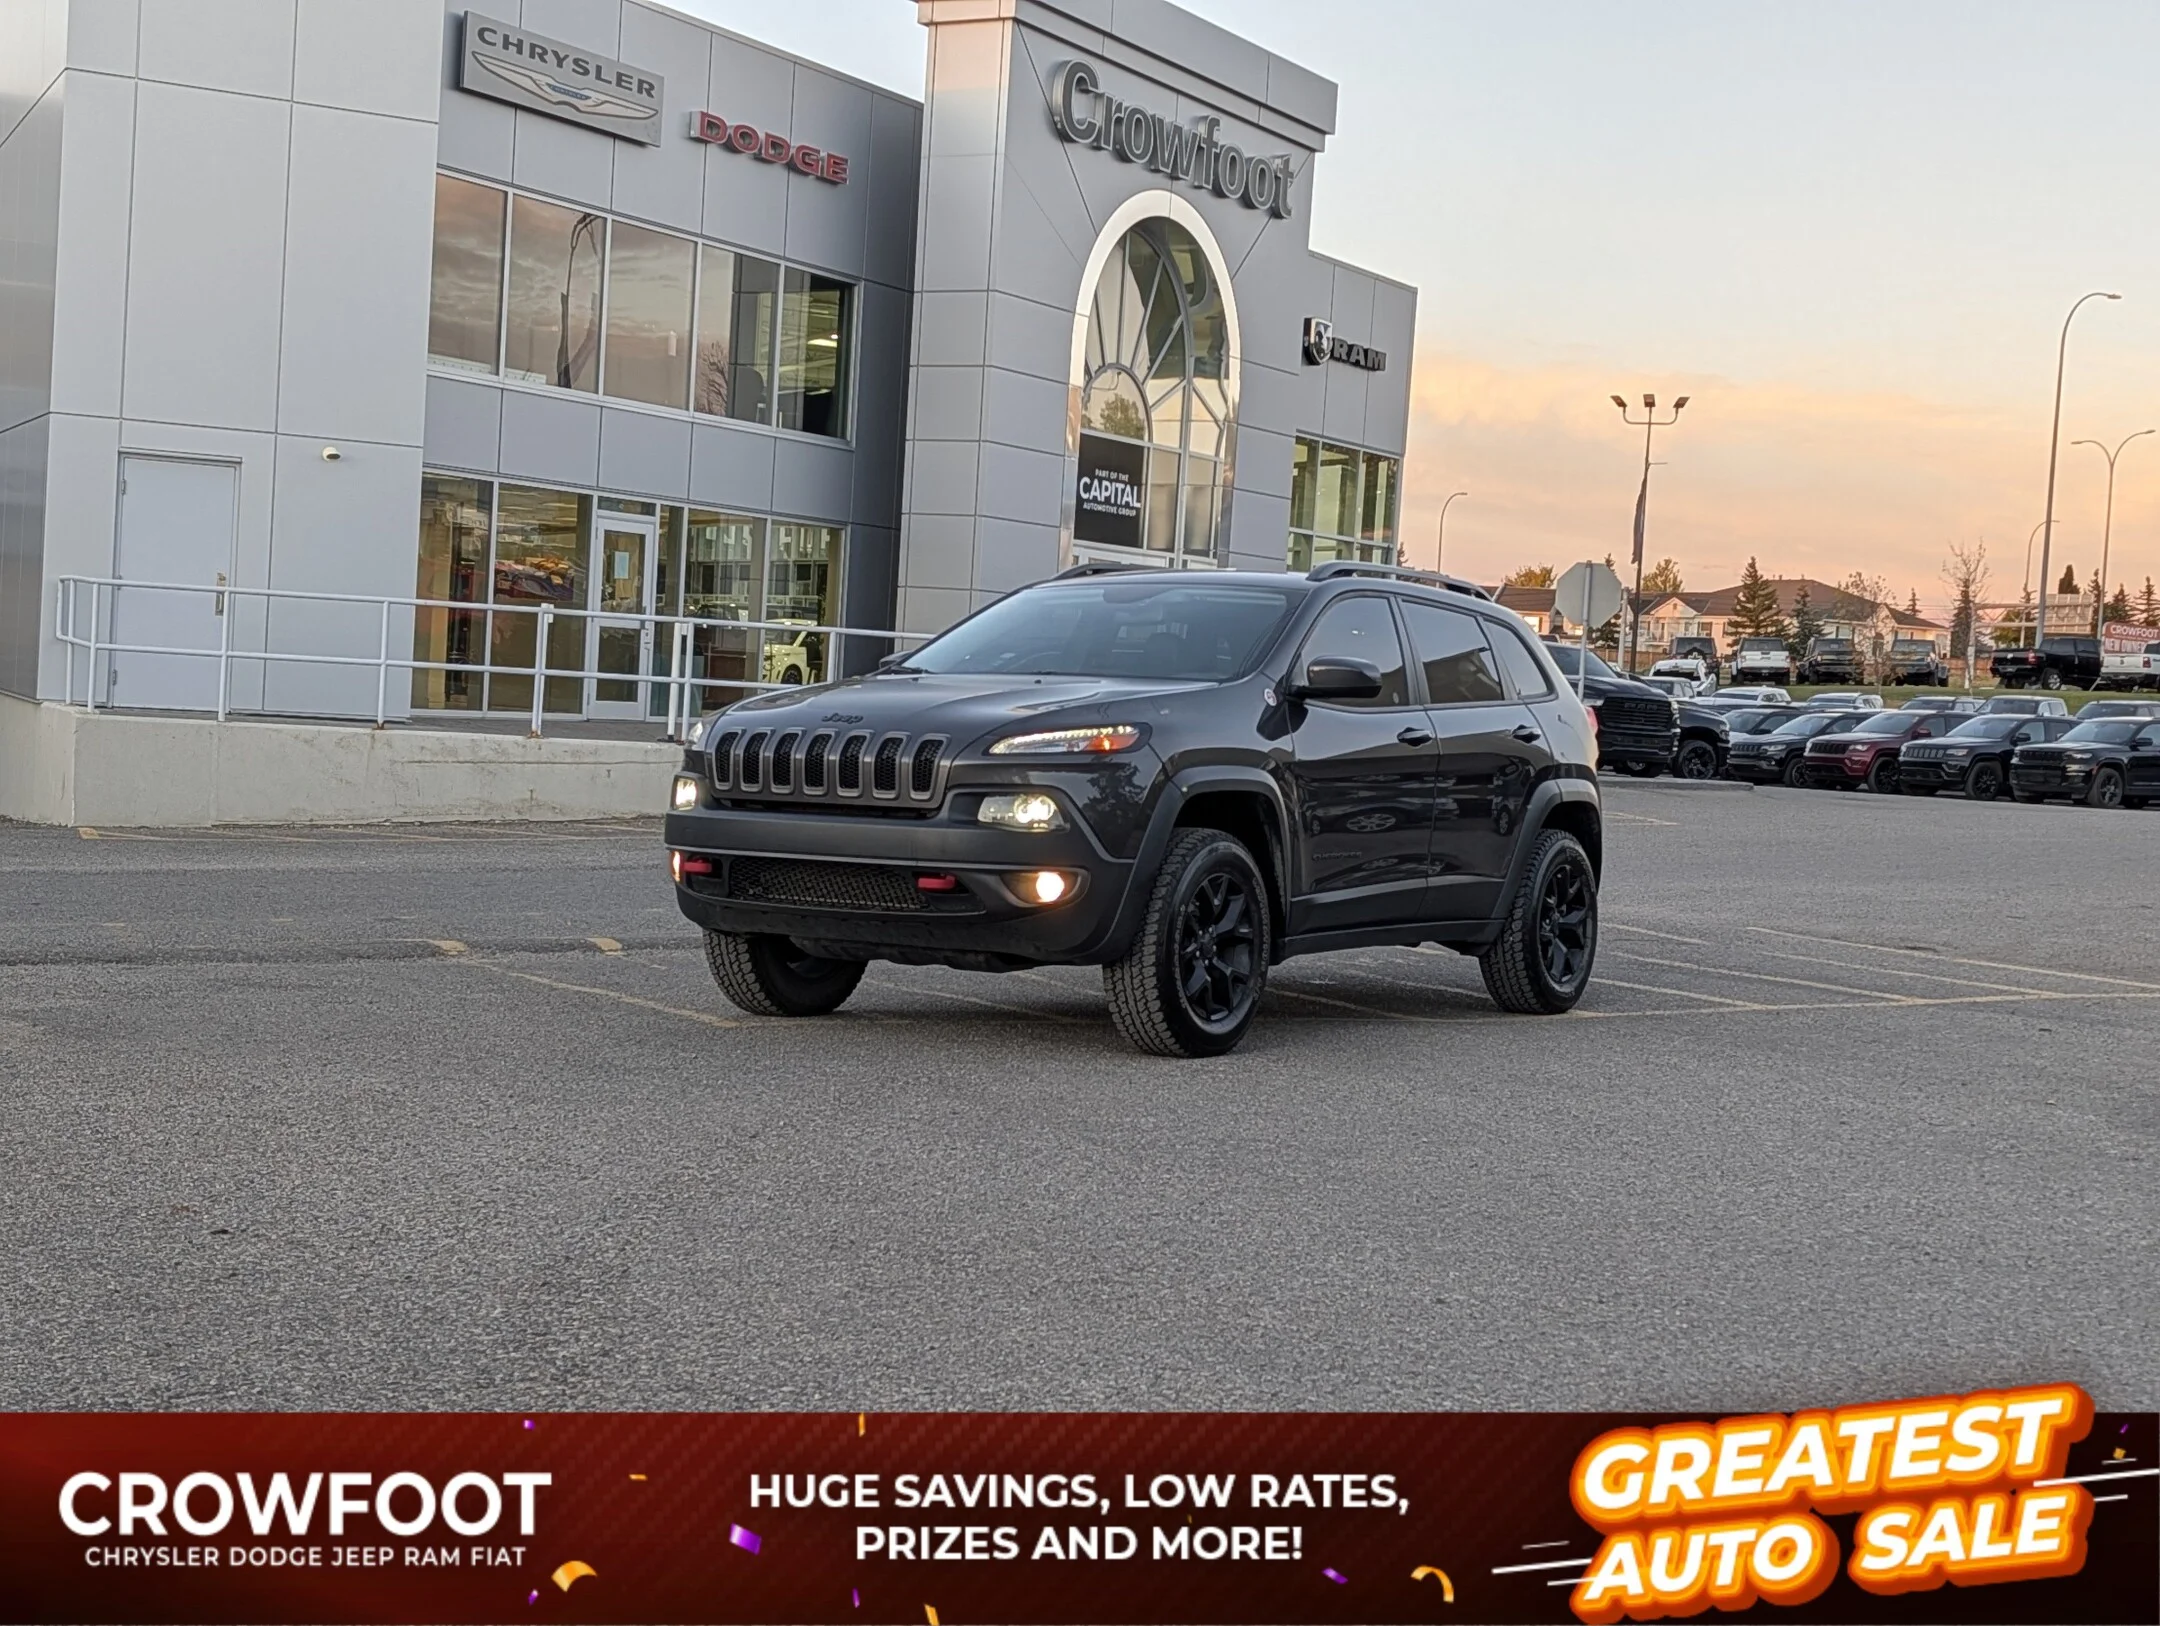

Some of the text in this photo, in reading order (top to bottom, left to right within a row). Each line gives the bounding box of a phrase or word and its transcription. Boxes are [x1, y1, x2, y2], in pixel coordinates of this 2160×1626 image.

[476, 26, 657, 99] CHRYSLER
[691, 110, 850, 185] DODGE
[1053, 59, 1296, 219] Crowfoot
[1330, 337, 1387, 371] RAM
[1095, 468, 1129, 482] PART OF THE
[1079, 476, 1141, 508] CAPITAL
[1083, 502, 1136, 516] AUTOMOTIVE GROUP
[2110, 624, 2159, 638] CROWFOOT
[821, 712, 864, 725] Jeep
